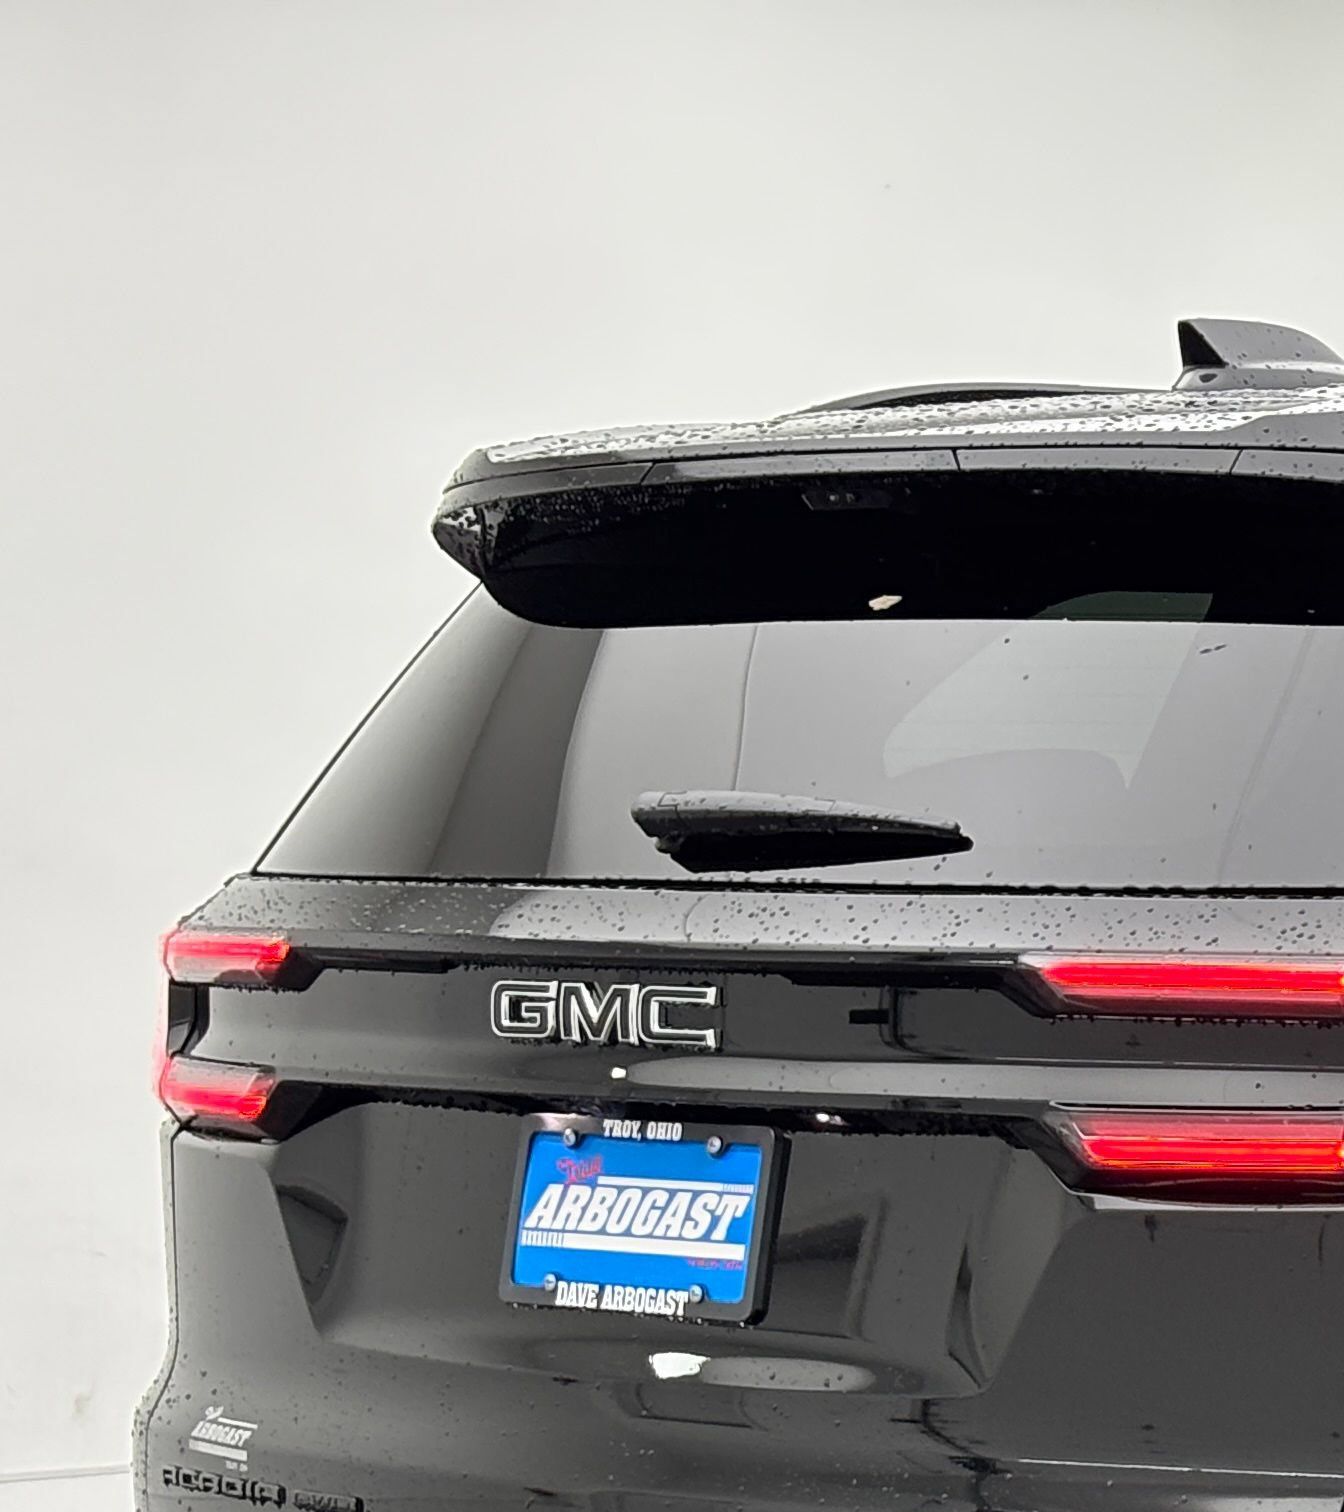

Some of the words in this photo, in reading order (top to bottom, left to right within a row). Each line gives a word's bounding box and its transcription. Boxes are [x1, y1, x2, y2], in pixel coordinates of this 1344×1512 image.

[490, 979, 722, 1049] GMC
[602, 1119, 642, 1141] TROY,
[646, 1121, 683, 1142] OHIO
[523, 1183, 751, 1242] ARBOGAST
[555, 1281, 599, 1309] DAVE
[601, 1285, 690, 1317] ARBOGAST
[162, 1464, 284, 1506] ACADIA
